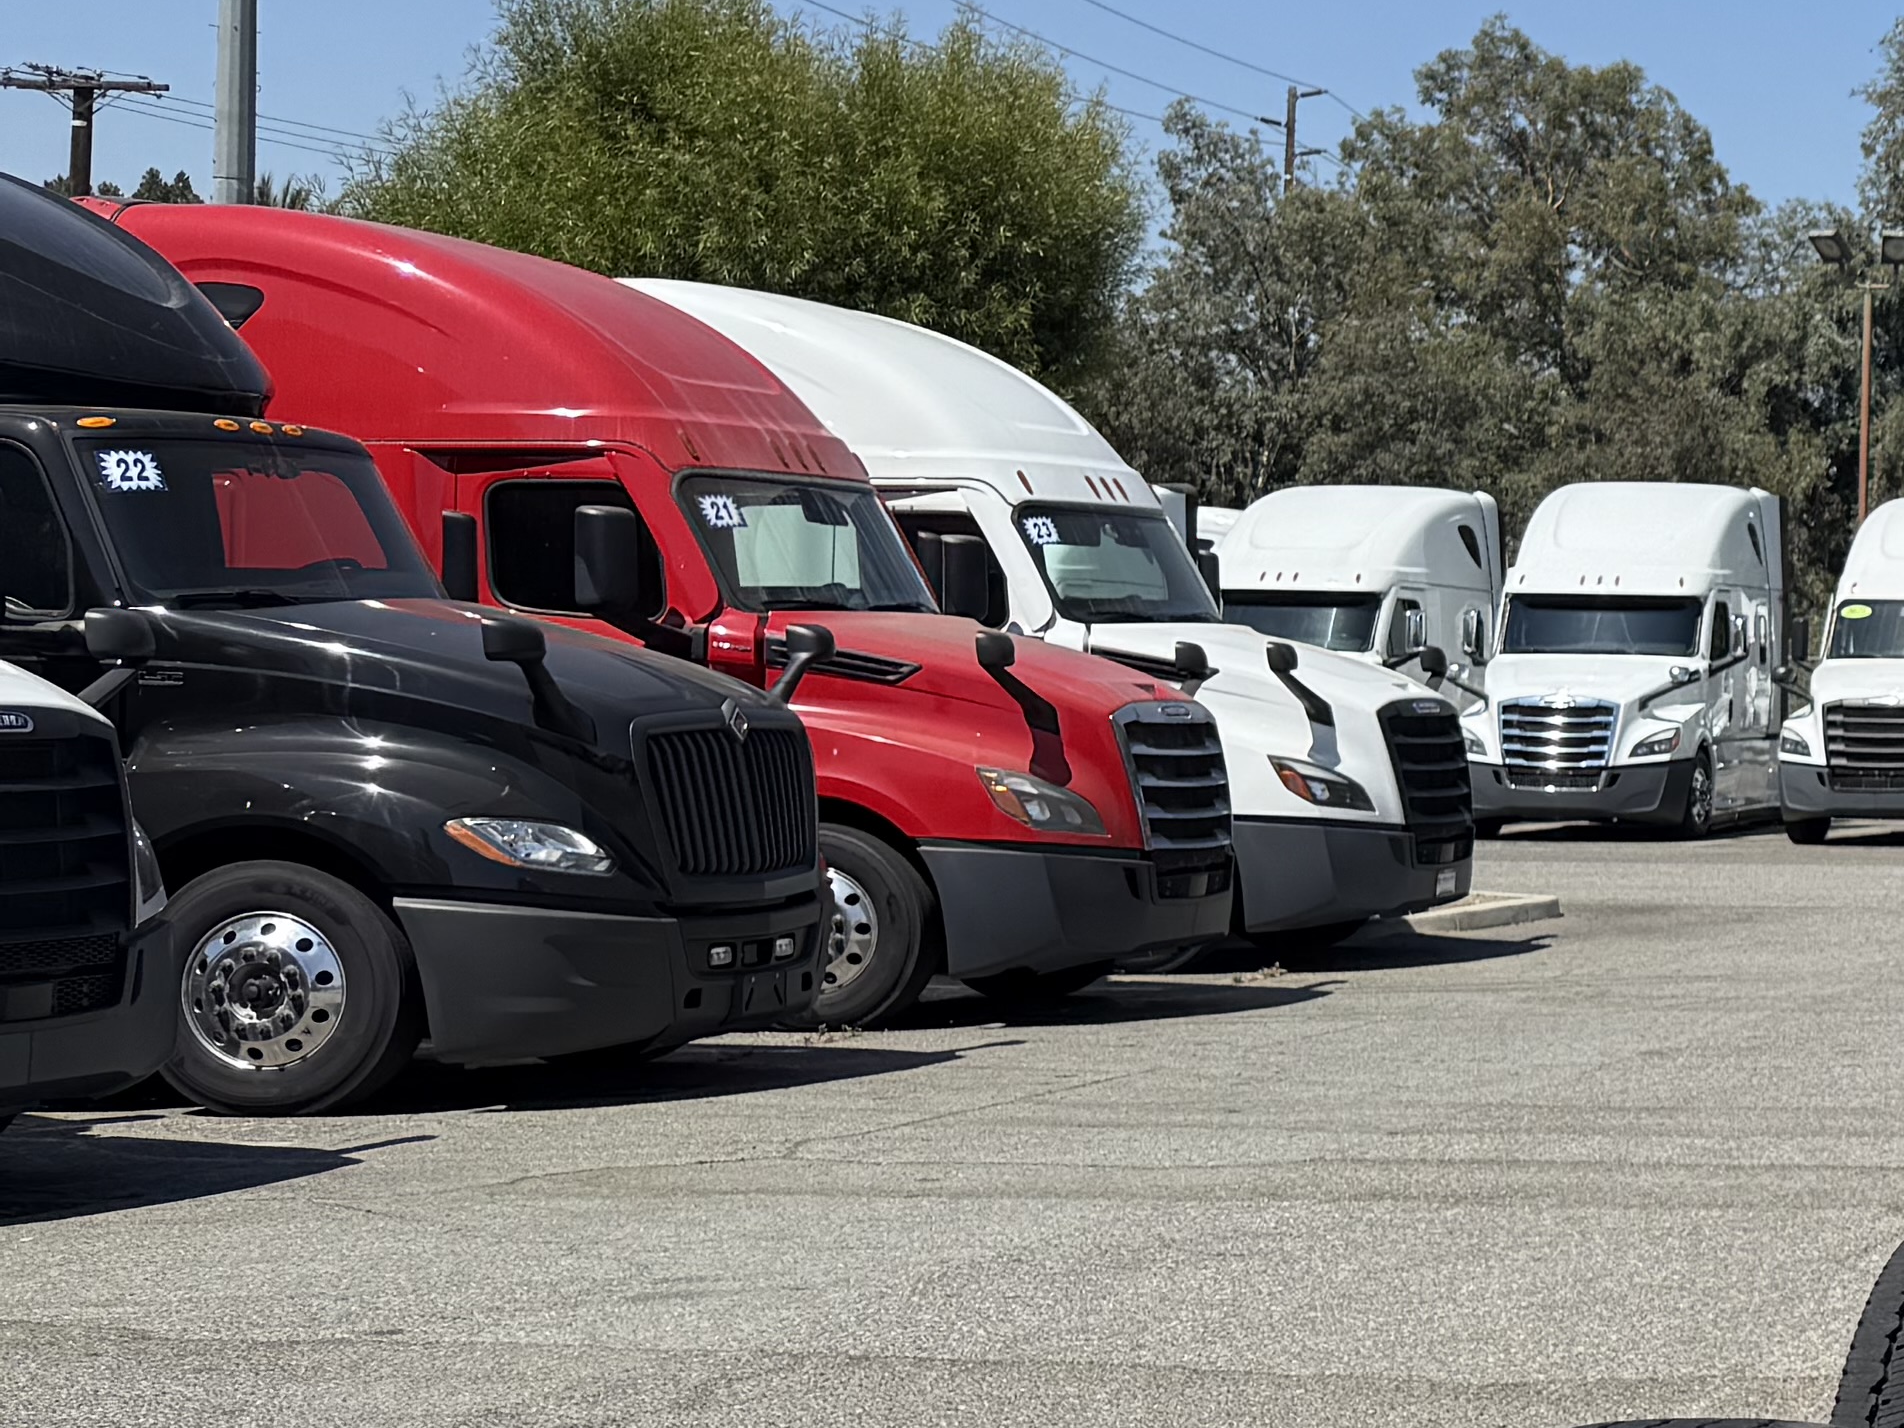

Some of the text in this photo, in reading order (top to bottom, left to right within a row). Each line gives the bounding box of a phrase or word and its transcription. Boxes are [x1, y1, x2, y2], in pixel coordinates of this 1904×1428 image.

[116, 457, 150, 482] 22
[710, 501, 733, 521] 21
[1033, 522, 1052, 538] 23
